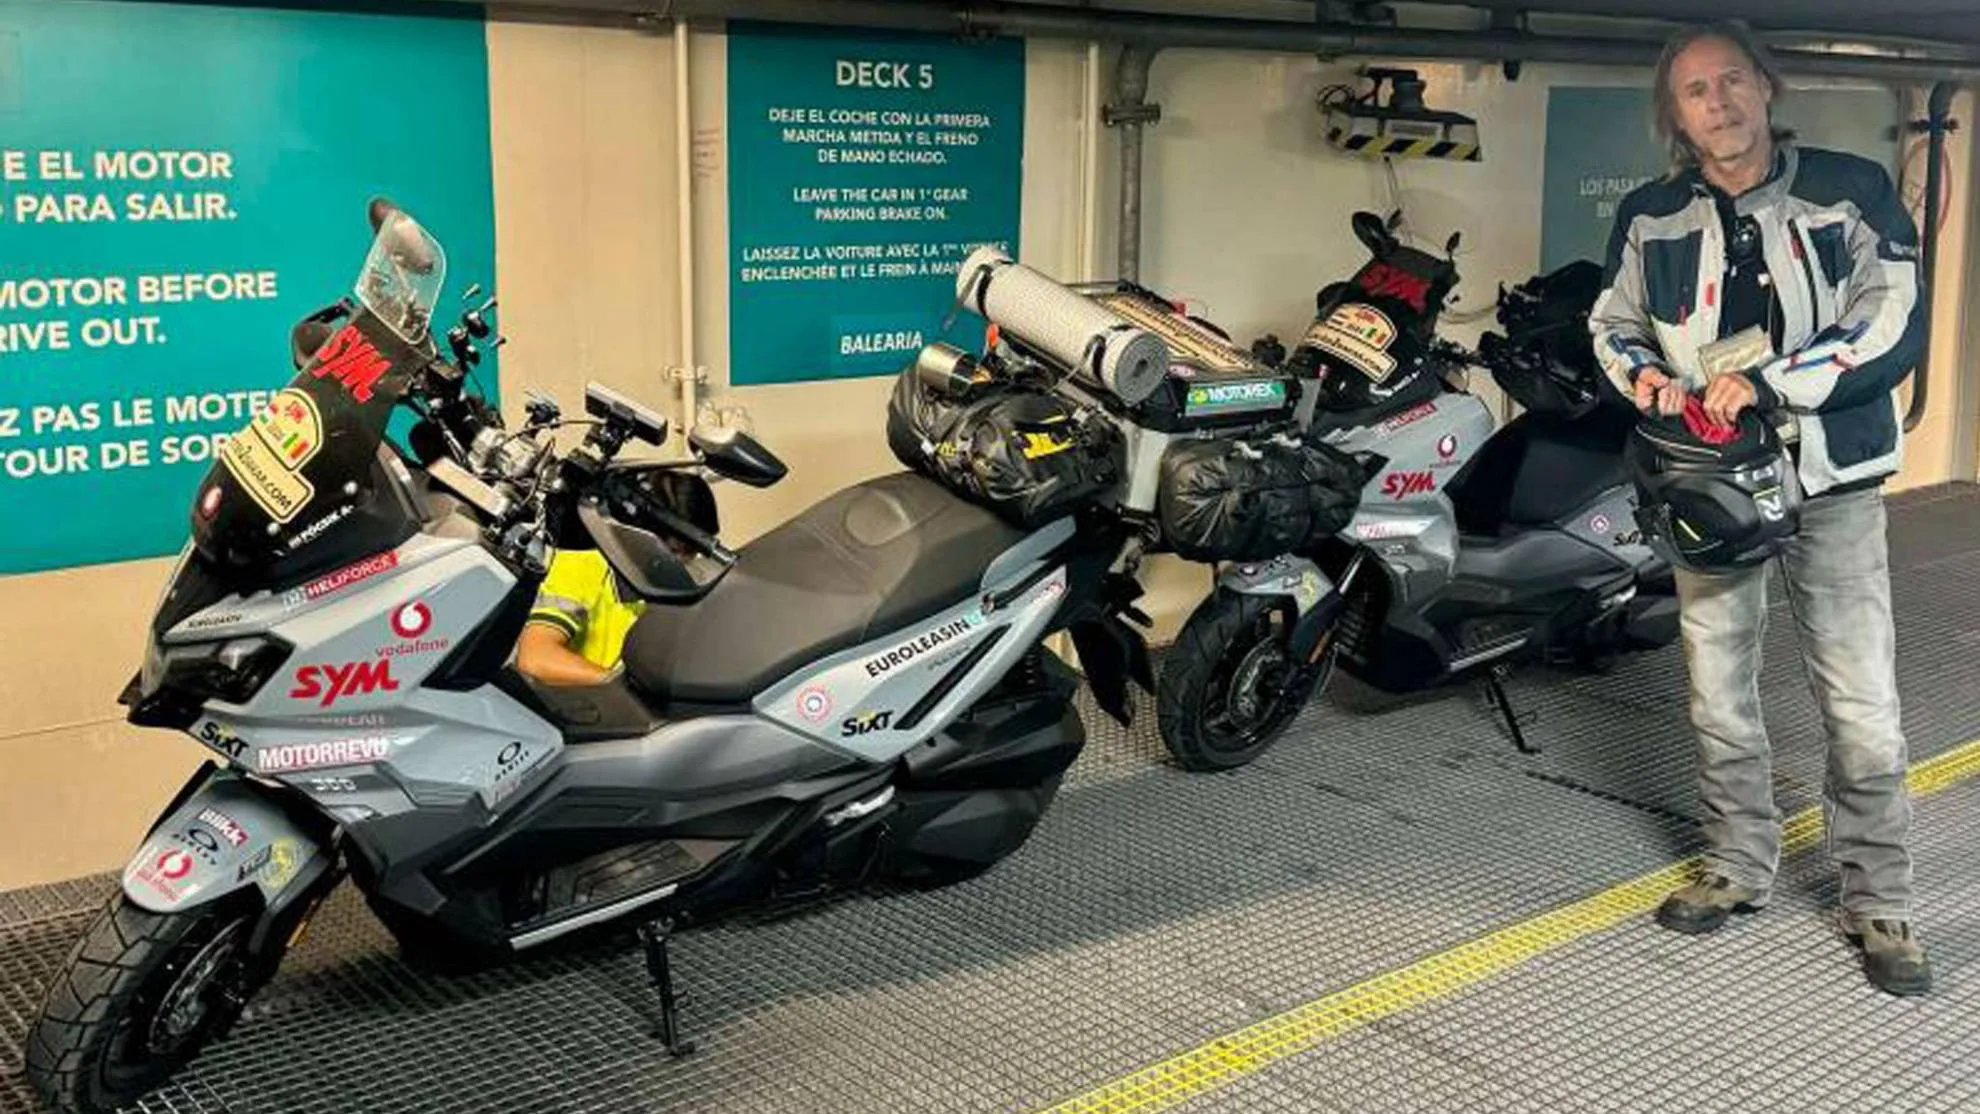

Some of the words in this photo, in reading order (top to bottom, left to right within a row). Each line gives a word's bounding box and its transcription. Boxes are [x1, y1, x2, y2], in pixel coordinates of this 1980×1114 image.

[836, 59, 912, 89] DECK
[918, 63, 933, 90] 5
[769, 107, 805, 123] DEJE
[808, 109, 825, 123] EL
[828, 109, 878, 125] COCHE
[881, 111, 913, 126] CON
[915, 112, 932, 126] LA
[934, 112, 991, 128] PRIMERA
[782, 128, 847, 144] MARCHA
[850, 130, 902, 145] METIDA
[904, 131, 914, 145] Y
[916, 132, 932, 146] EL
[935, 132, 979, 146] FRENO
[39, 150, 84, 180] EL
[94, 150, 233, 180] MOTOR
[818, 149, 837, 164] DE
[841, 149, 886, 164] MANO
[15, 193, 116, 223] PARA
[125, 192, 239, 221] SALIR.
[793, 187, 837, 202] LEAVE
[841, 187, 867, 202] THE
[871, 187, 899, 202] CAR
[900, 187, 915, 201] IN
[932, 187, 968, 201] GEAR
[815, 206, 876, 221] PARKING
[878, 206, 922, 220] BRAKE
[743, 246, 800, 262] LAISSEZ
[803, 246, 821, 260] LA
[824, 245, 883, 260] VOITURE
[886, 243, 919, 258] AVEC
[923, 243, 940, 257] LA
[741, 261, 837, 282] ENCLENCHÉE
[841, 264, 856, 279] ET
[860, 264, 876, 278] LE
[878, 263, 917, 278] FREIN
[918, 258, 930, 275] À
[138, 271, 278, 303] BEFORE
[81, 316, 167, 348] OUT.
[311, 325, 393, 403] SYM
[33, 402, 100, 434] PAS
[113, 398, 154, 428] LE
[166, 386, 276, 425] MOTE
[0, 445, 90, 479] OUR
[101, 440, 149, 470] DE
[1380, 470, 1436, 501] SYM
[288, 658, 400, 708] SYM
